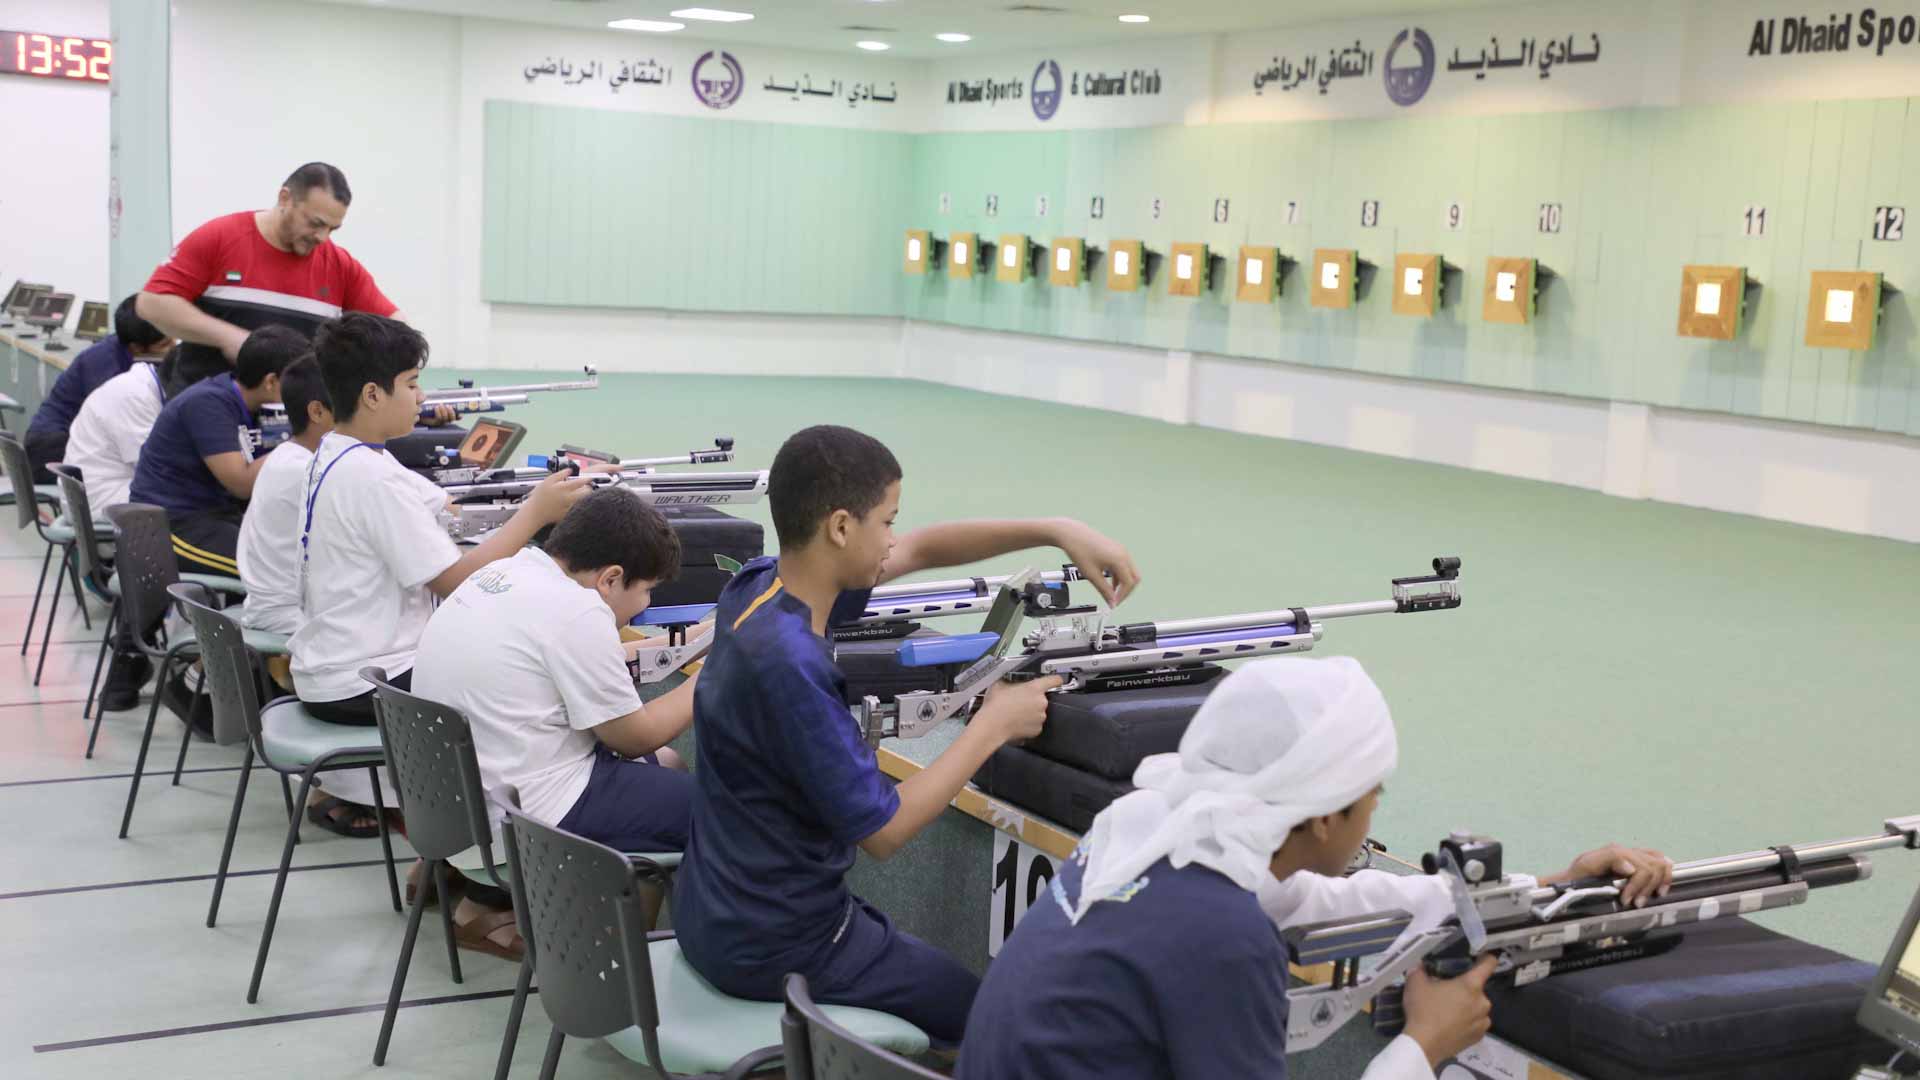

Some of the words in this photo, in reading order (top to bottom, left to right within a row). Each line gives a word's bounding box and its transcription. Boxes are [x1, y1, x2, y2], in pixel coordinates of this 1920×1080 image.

[1748, 18, 1775, 56] Al
[1781, 13, 1852, 55] Dhaid
[1857, 8, 1920, 56] Spo
[17, 34, 111, 80] 13:52
[523, 55, 604, 84] الرياضي
[1318, 40, 1374, 94] الثقافي
[1447, 36, 1536, 79] الذيد
[1538, 32, 1601, 79] نادي
[609, 58, 673, 94] الثقافي
[986, 76, 1023, 106] Sports
[1084, 71, 1127, 97] Cultural
[1130, 68, 1162, 95] Club
[1254, 56, 1317, 95] الرياضي
[848, 80, 898, 109] نادي
[987, 195, 998, 216] 2
[1091, 197, 1104, 218] 4
[1288, 201, 1296, 224] 7
[1361, 201, 1379, 226] 8
[1449, 203, 1459, 228] 9
[1539, 203, 1562, 233] 10
[1745, 207, 1766, 235] 11
[1873, 206, 1905, 240] 12
[654, 494, 731, 505] WALTHER
[832, 628, 893, 638] inwerkbau
[1106, 674, 1191, 688] Feinwerkbau
